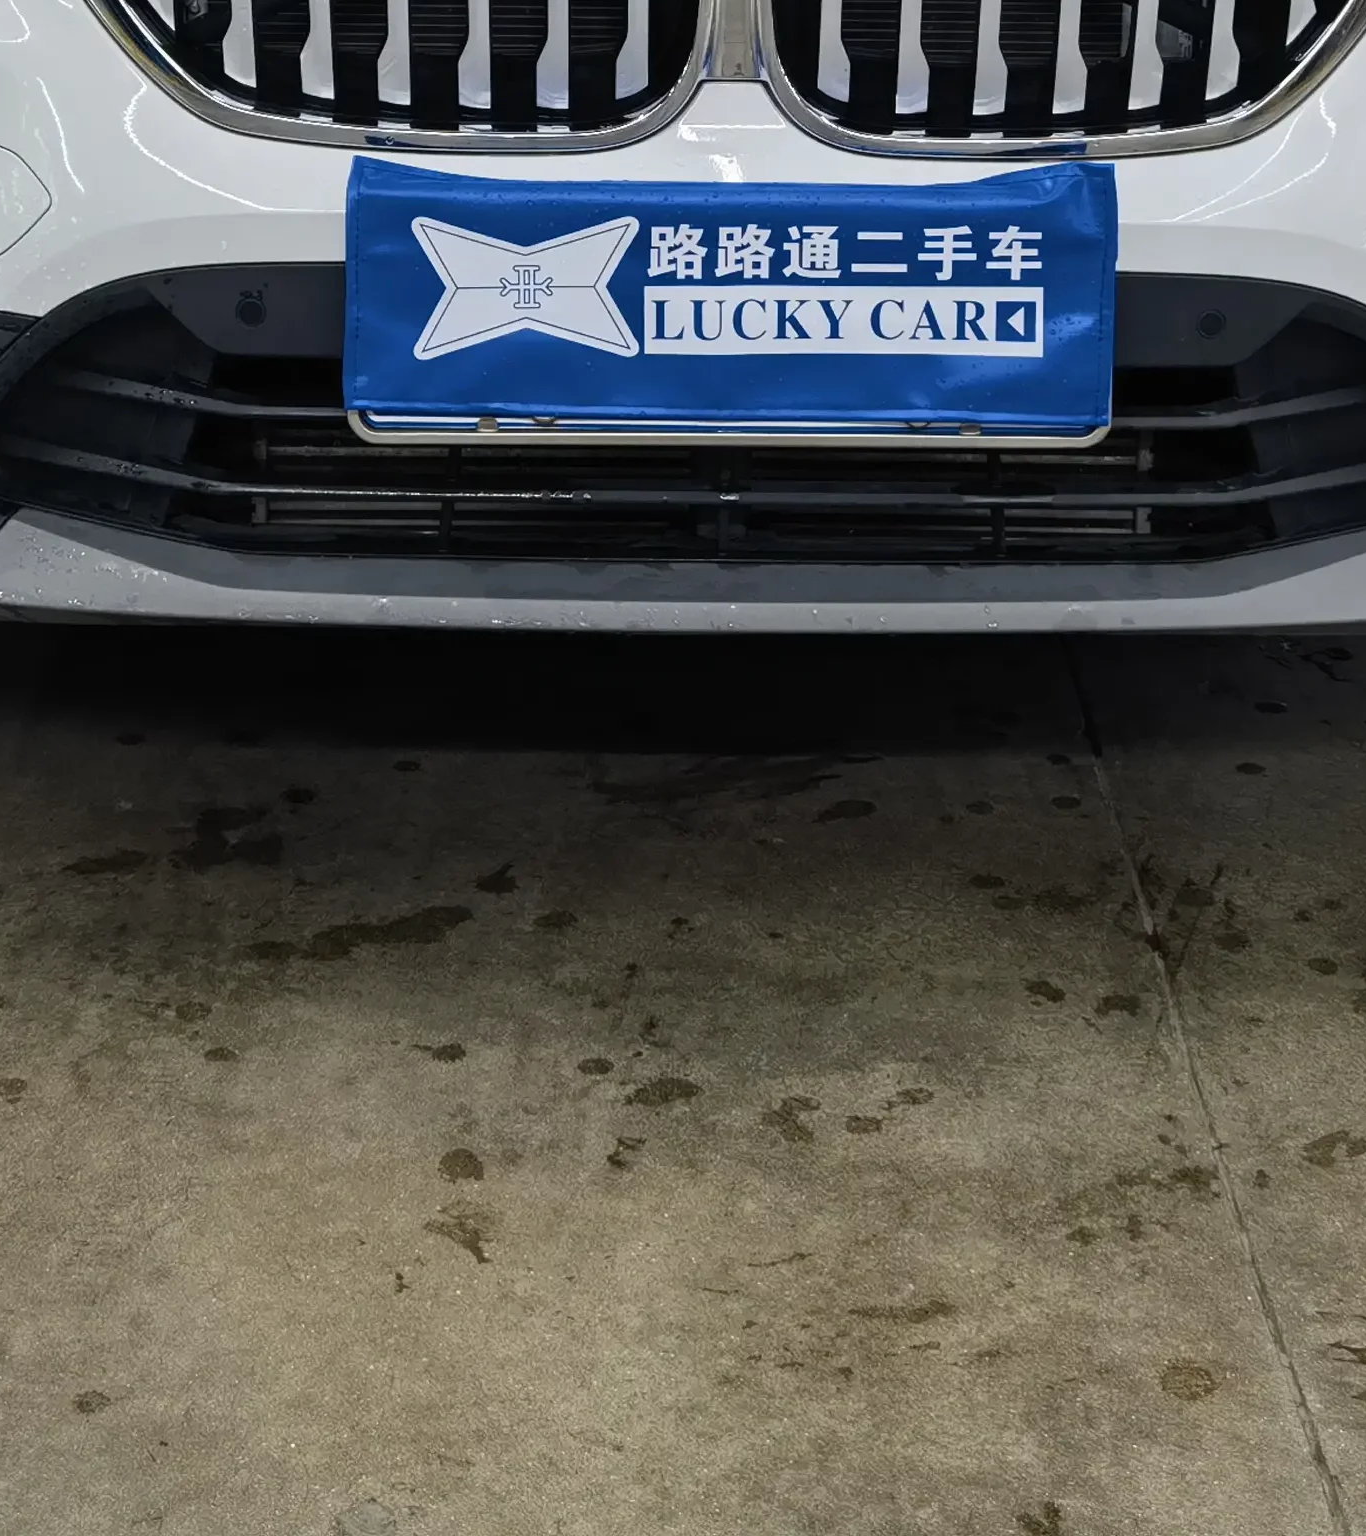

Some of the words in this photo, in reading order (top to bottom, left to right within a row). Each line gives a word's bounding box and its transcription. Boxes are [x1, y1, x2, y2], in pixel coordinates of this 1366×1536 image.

[647, 224, 1044, 282] 路路通二手车
[649, 298, 851, 343] LUCKY
[868, 299, 996, 342] CAR
